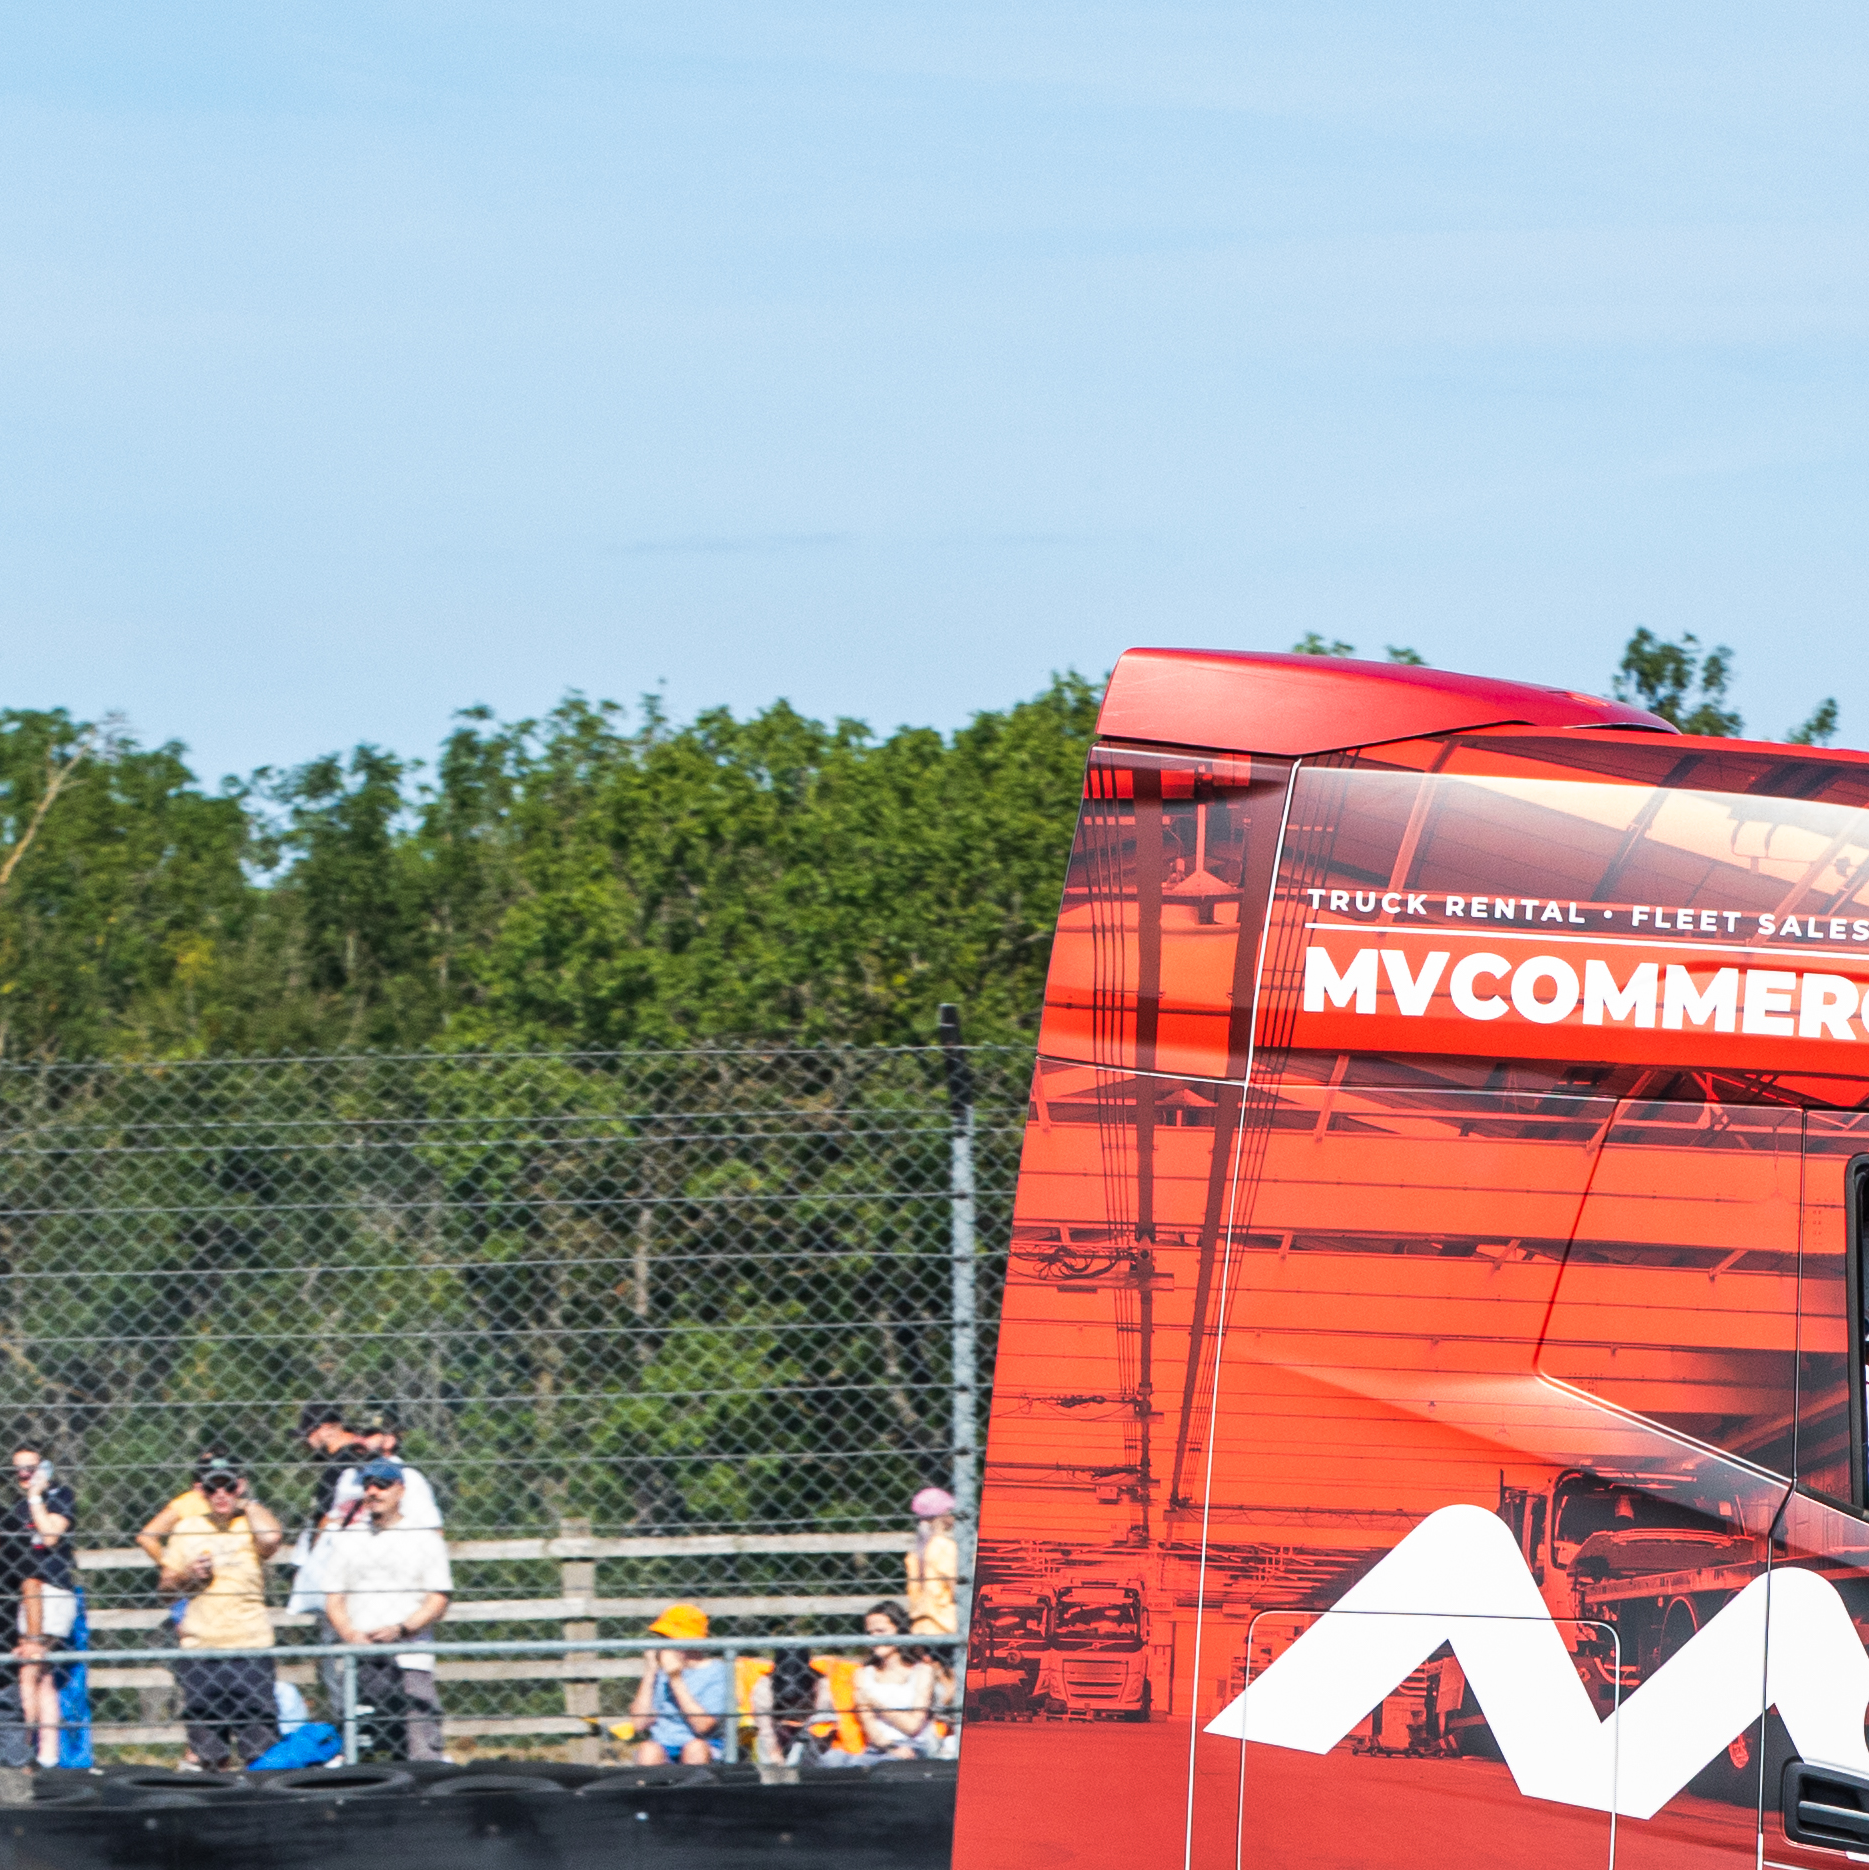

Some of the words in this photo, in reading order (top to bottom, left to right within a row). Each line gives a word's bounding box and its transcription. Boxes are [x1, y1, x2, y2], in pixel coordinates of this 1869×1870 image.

[1306, 888, 1428, 916] TRUCK
[1445, 895, 1588, 924] RENTAL
[1631, 905, 1743, 933] FLEET
